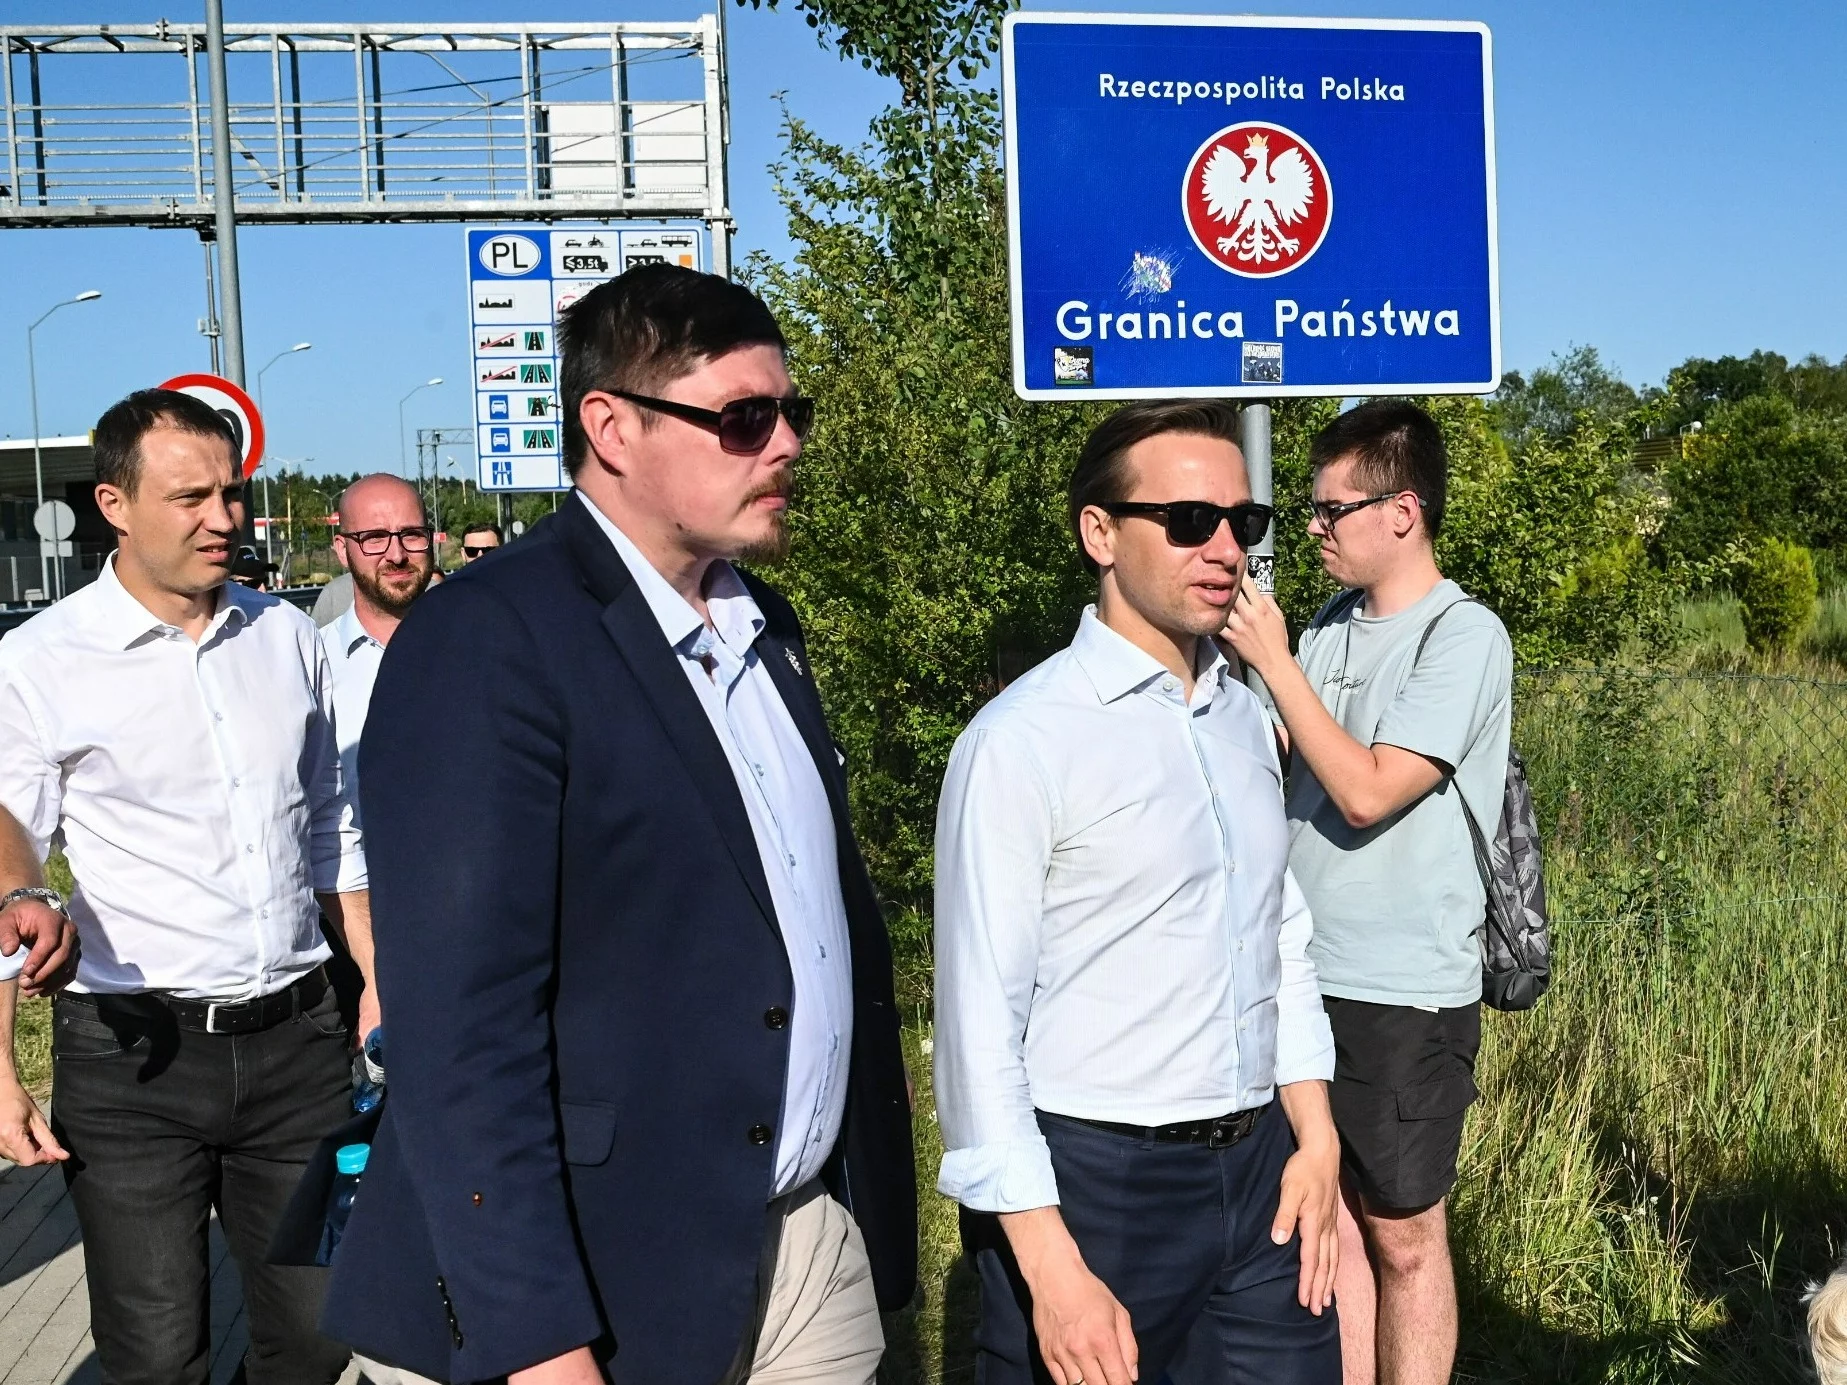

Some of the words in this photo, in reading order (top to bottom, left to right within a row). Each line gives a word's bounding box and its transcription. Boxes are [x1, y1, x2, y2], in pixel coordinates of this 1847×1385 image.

[1099, 73, 1304, 105] Rzeczpospolita
[1321, 76, 1405, 101] Polska
[492, 241, 529, 269] PL
[1056, 300, 1244, 341] Granica
[1275, 299, 1460, 338] Państwa
